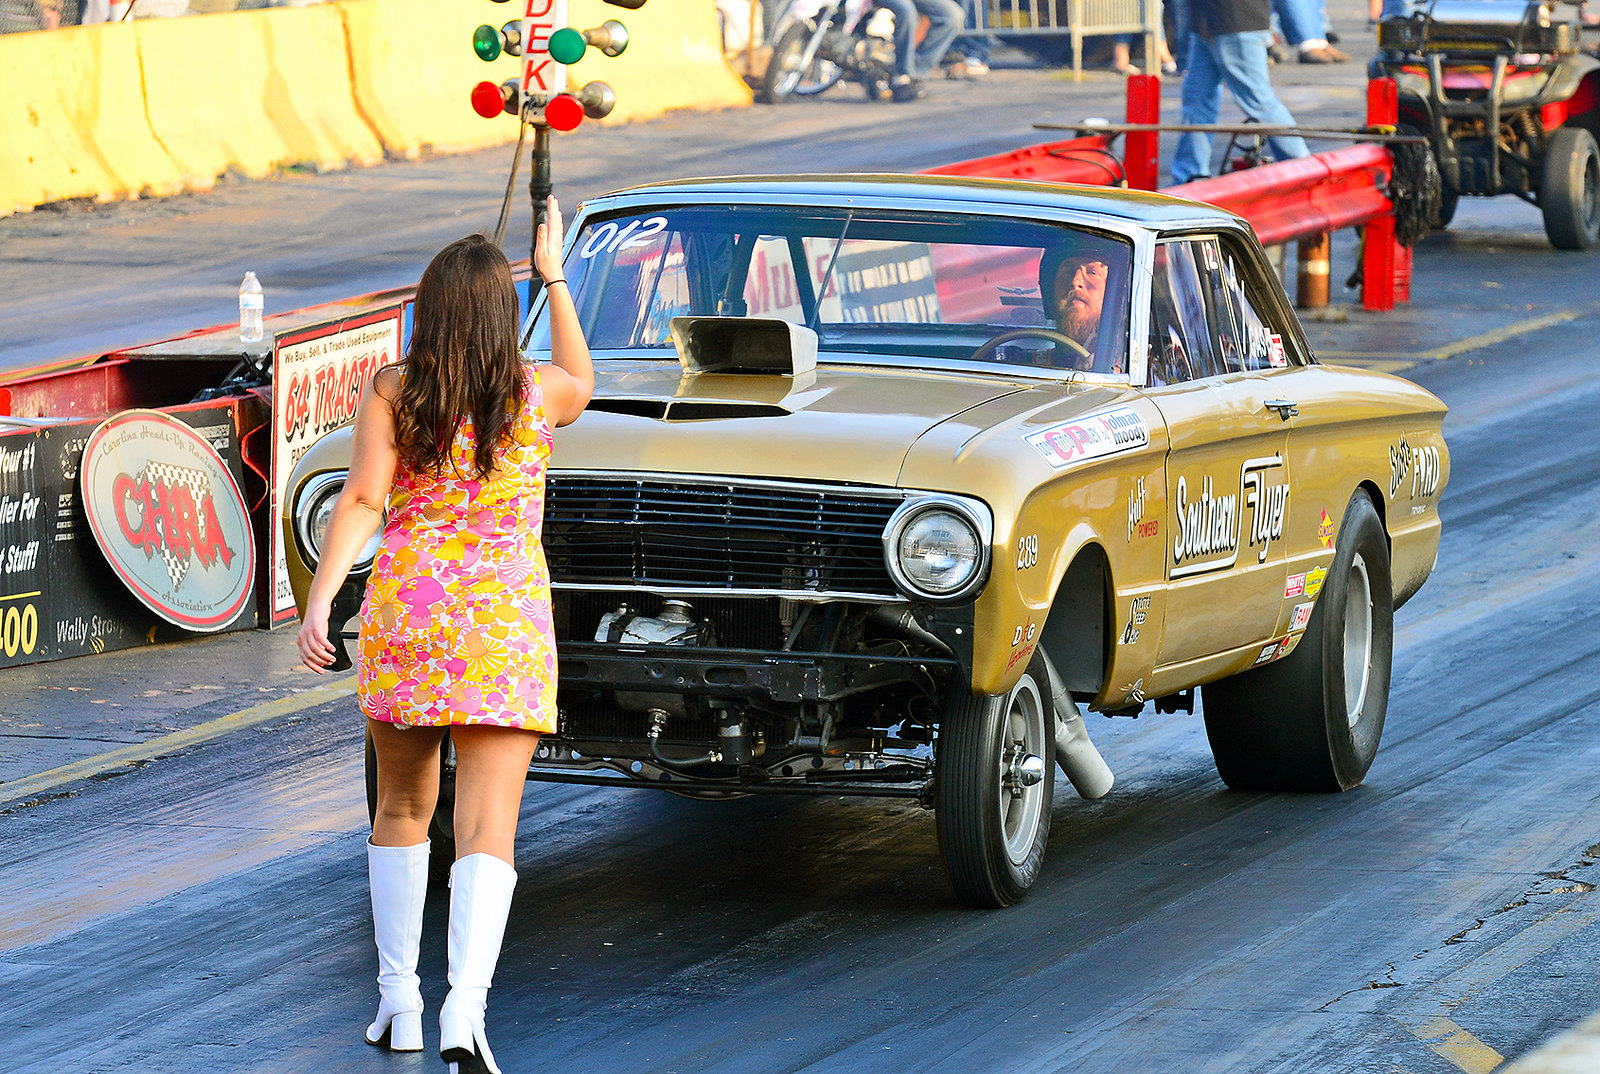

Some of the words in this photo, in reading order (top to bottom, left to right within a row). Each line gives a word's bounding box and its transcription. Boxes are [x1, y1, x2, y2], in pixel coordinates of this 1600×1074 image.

[580, 217, 669, 259] 012
[284, 352, 294, 364] We
[329, 340, 345, 353] Trade
[346, 334, 361, 348] Used
[362, 328, 392, 345] Equipment
[284, 370, 310, 442] 64
[313, 349, 389, 435] TRACTO
[1098, 412, 1142, 434] holman
[1112, 425, 1146, 445] moody
[102, 430, 138, 456] Carolina
[188, 442, 217, 478] Racing
[19, 491, 40, 522] For
[1173, 474, 1237, 565] Southern
[1242, 456, 1290, 564] Flyer
[5, 540, 40, 574] Stuff!
[1017, 533, 1039, 570] 289
[162, 591, 213, 611] Association
[56, 616, 89, 646] Wally
